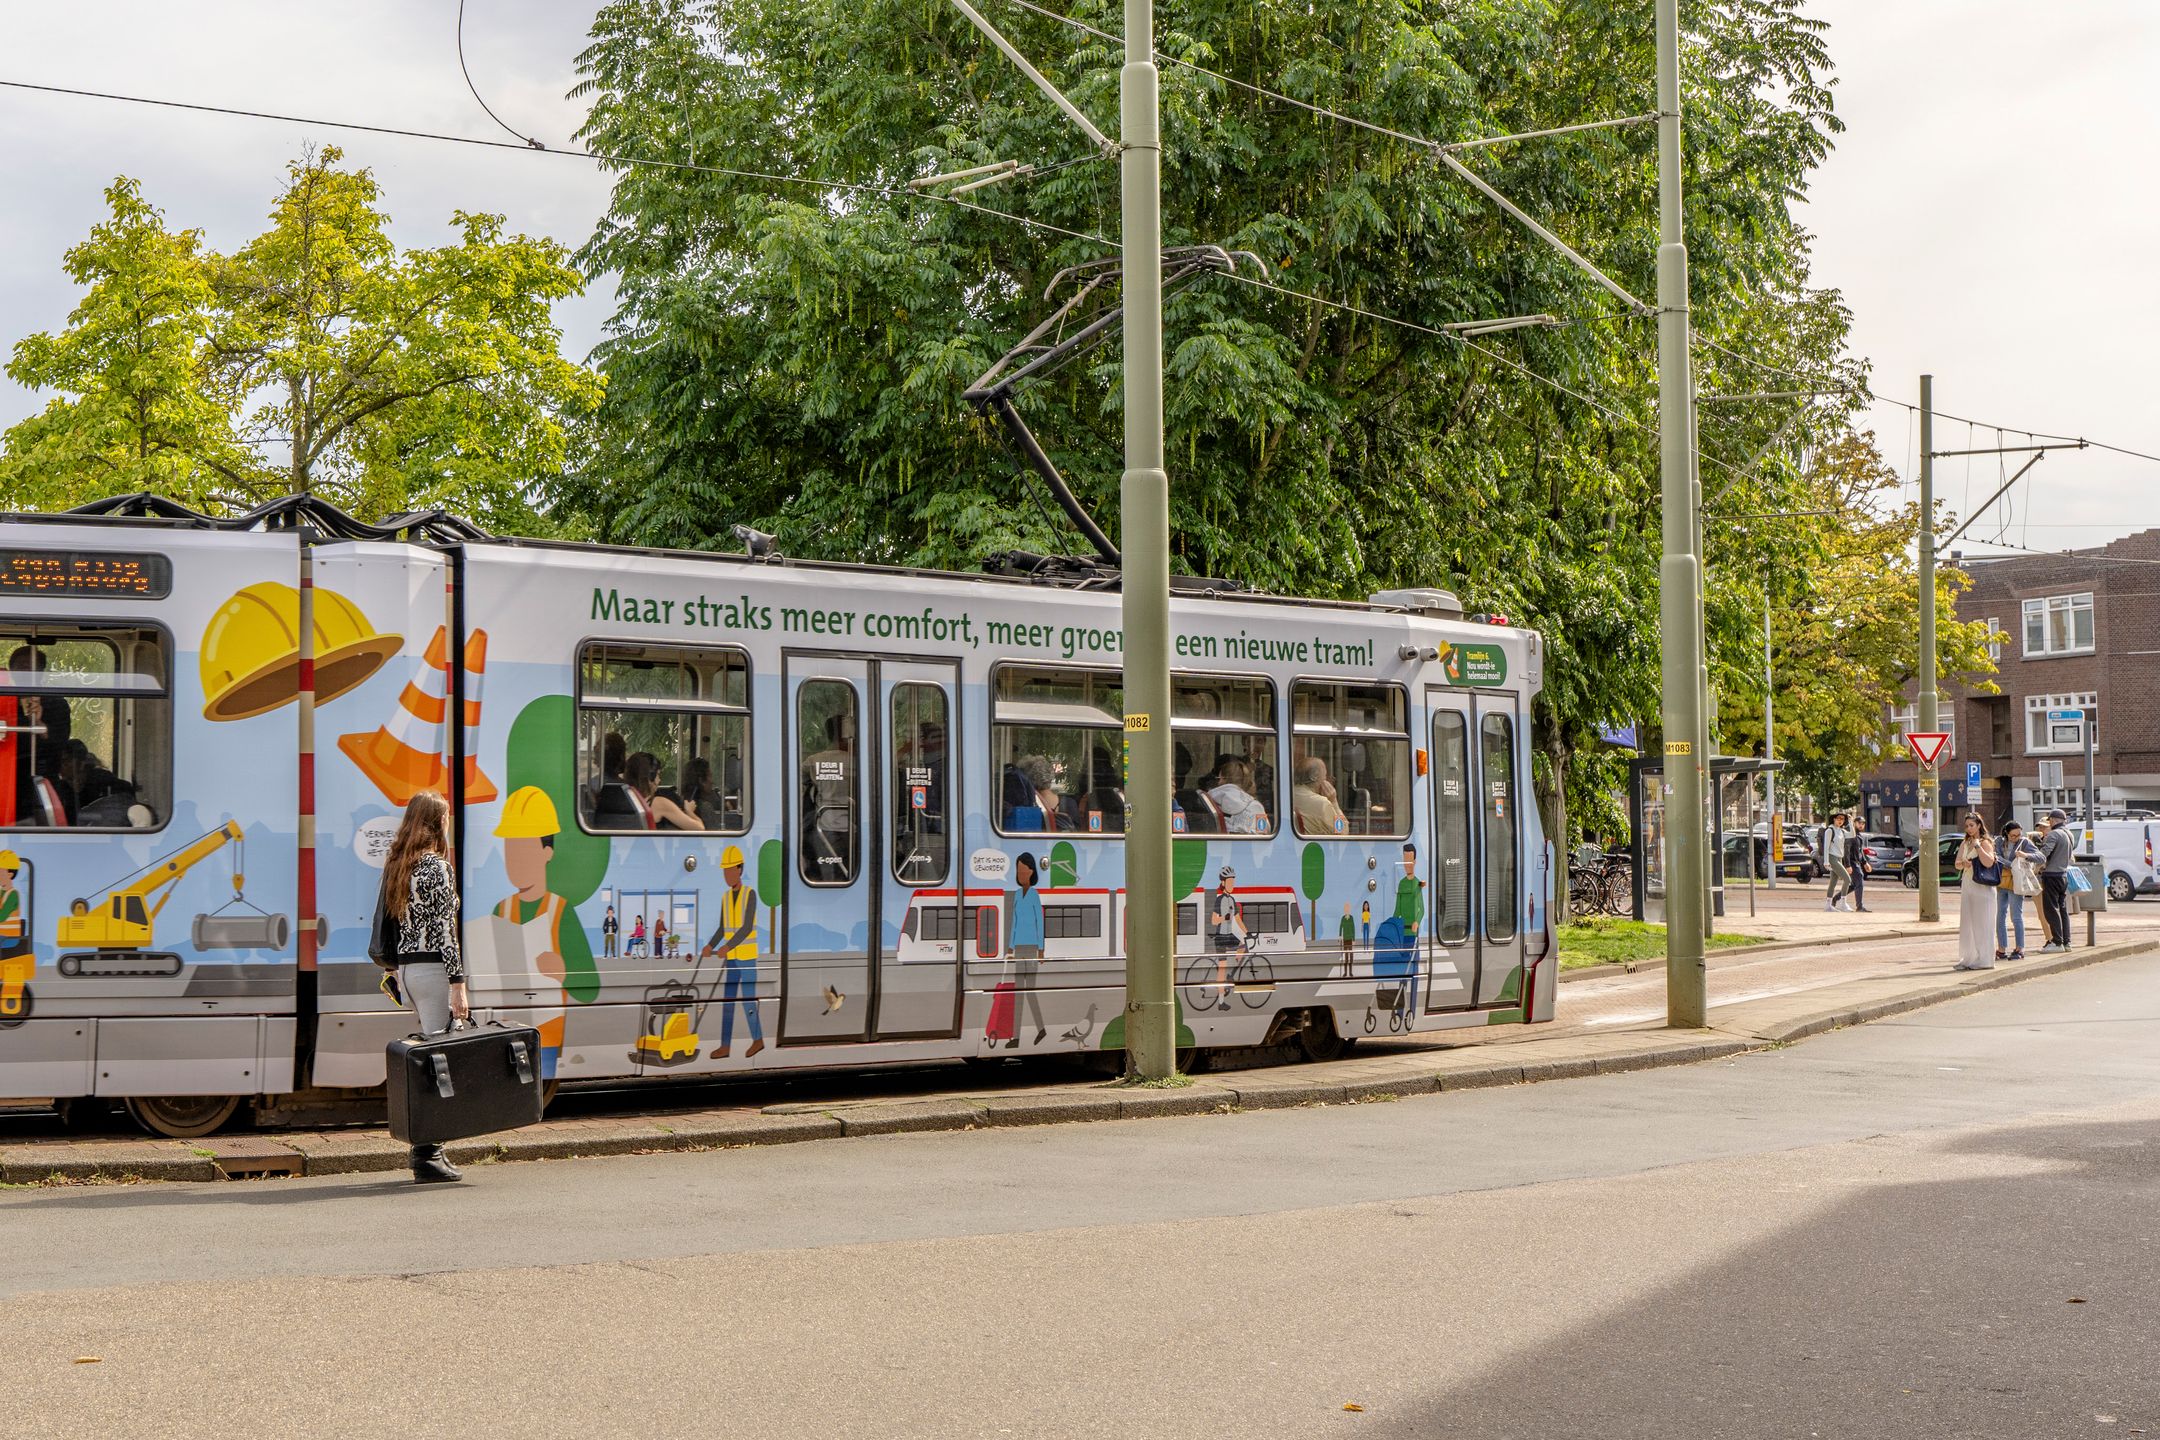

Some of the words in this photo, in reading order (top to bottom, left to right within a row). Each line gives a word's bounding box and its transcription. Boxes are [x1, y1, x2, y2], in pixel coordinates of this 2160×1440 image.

[591, 588, 674, 624] Maar
[683, 595, 772, 630] straks
[781, 608, 855, 635] meer
[863, 608, 979, 649] comfort,
[987, 621, 1054, 647] meer
[1175, 633, 1217, 657] een
[1223, 630, 1307, 663] nieuwe
[1313, 637, 1373, 667] tram!
[1665, 744, 1690, 752] M1083
[1970, 765, 1978, 777] P
[825, 856, 842, 864] open
[909, 855, 924, 863] open
